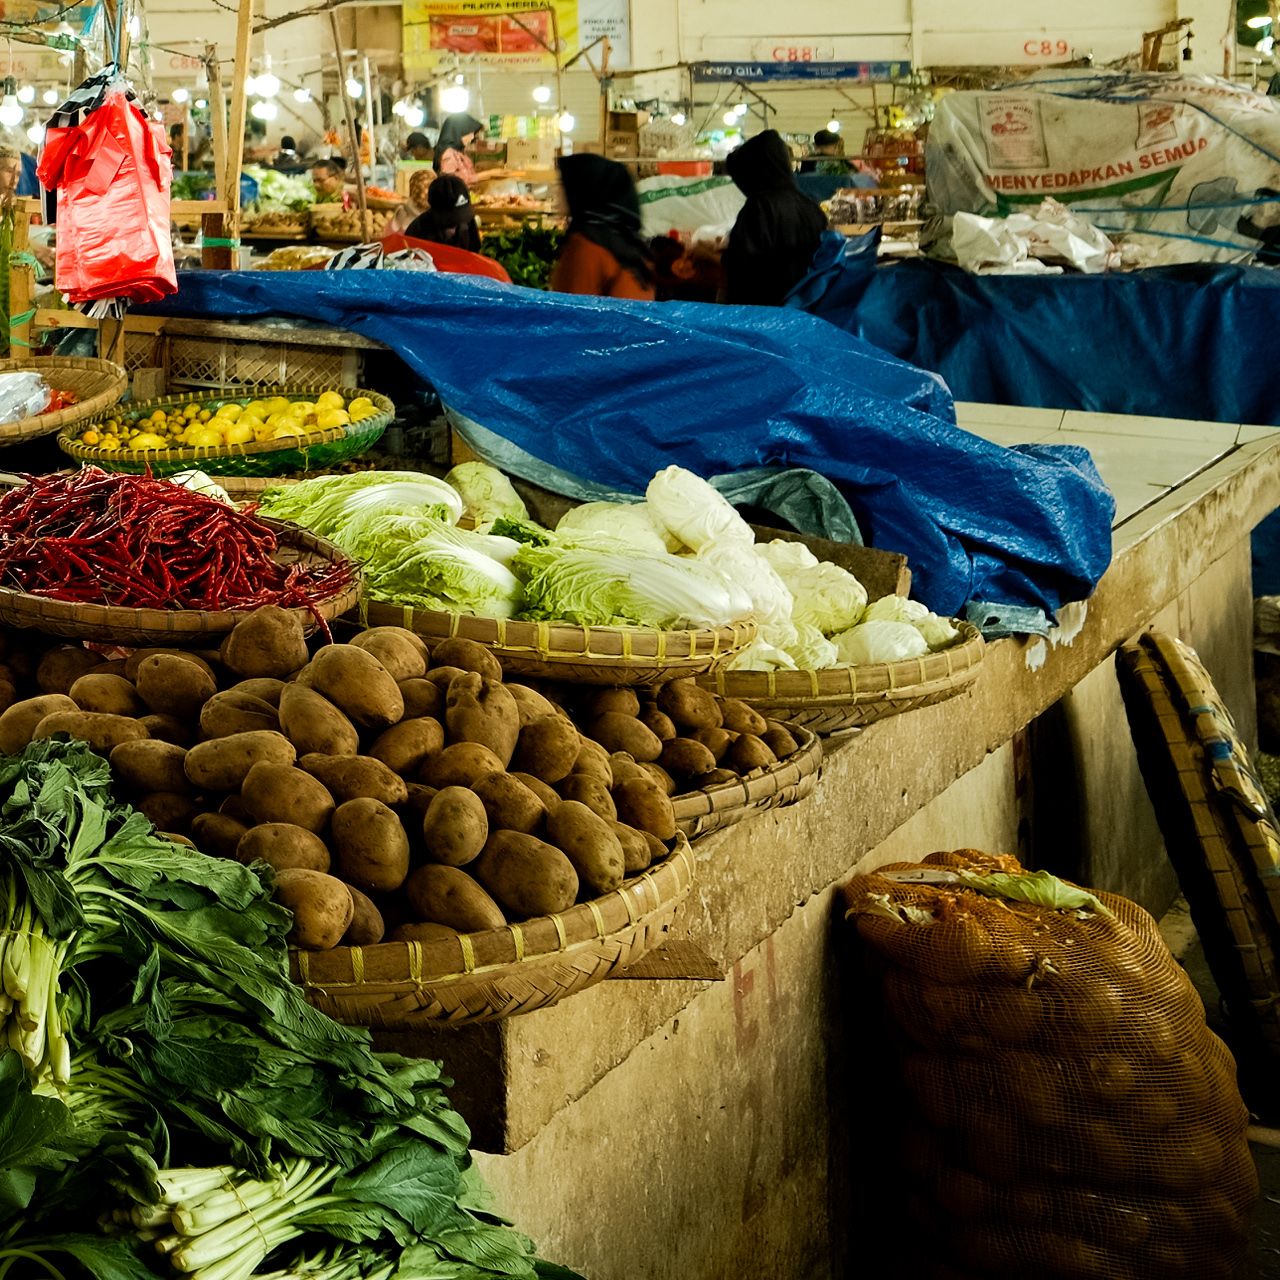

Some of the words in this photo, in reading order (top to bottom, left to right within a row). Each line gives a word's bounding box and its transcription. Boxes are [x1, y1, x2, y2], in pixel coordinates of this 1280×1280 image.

[772, 46, 812, 62] C88
[1023, 39, 1068, 56] C89
[987, 161, 1135, 190] MENYEDAPKAN
